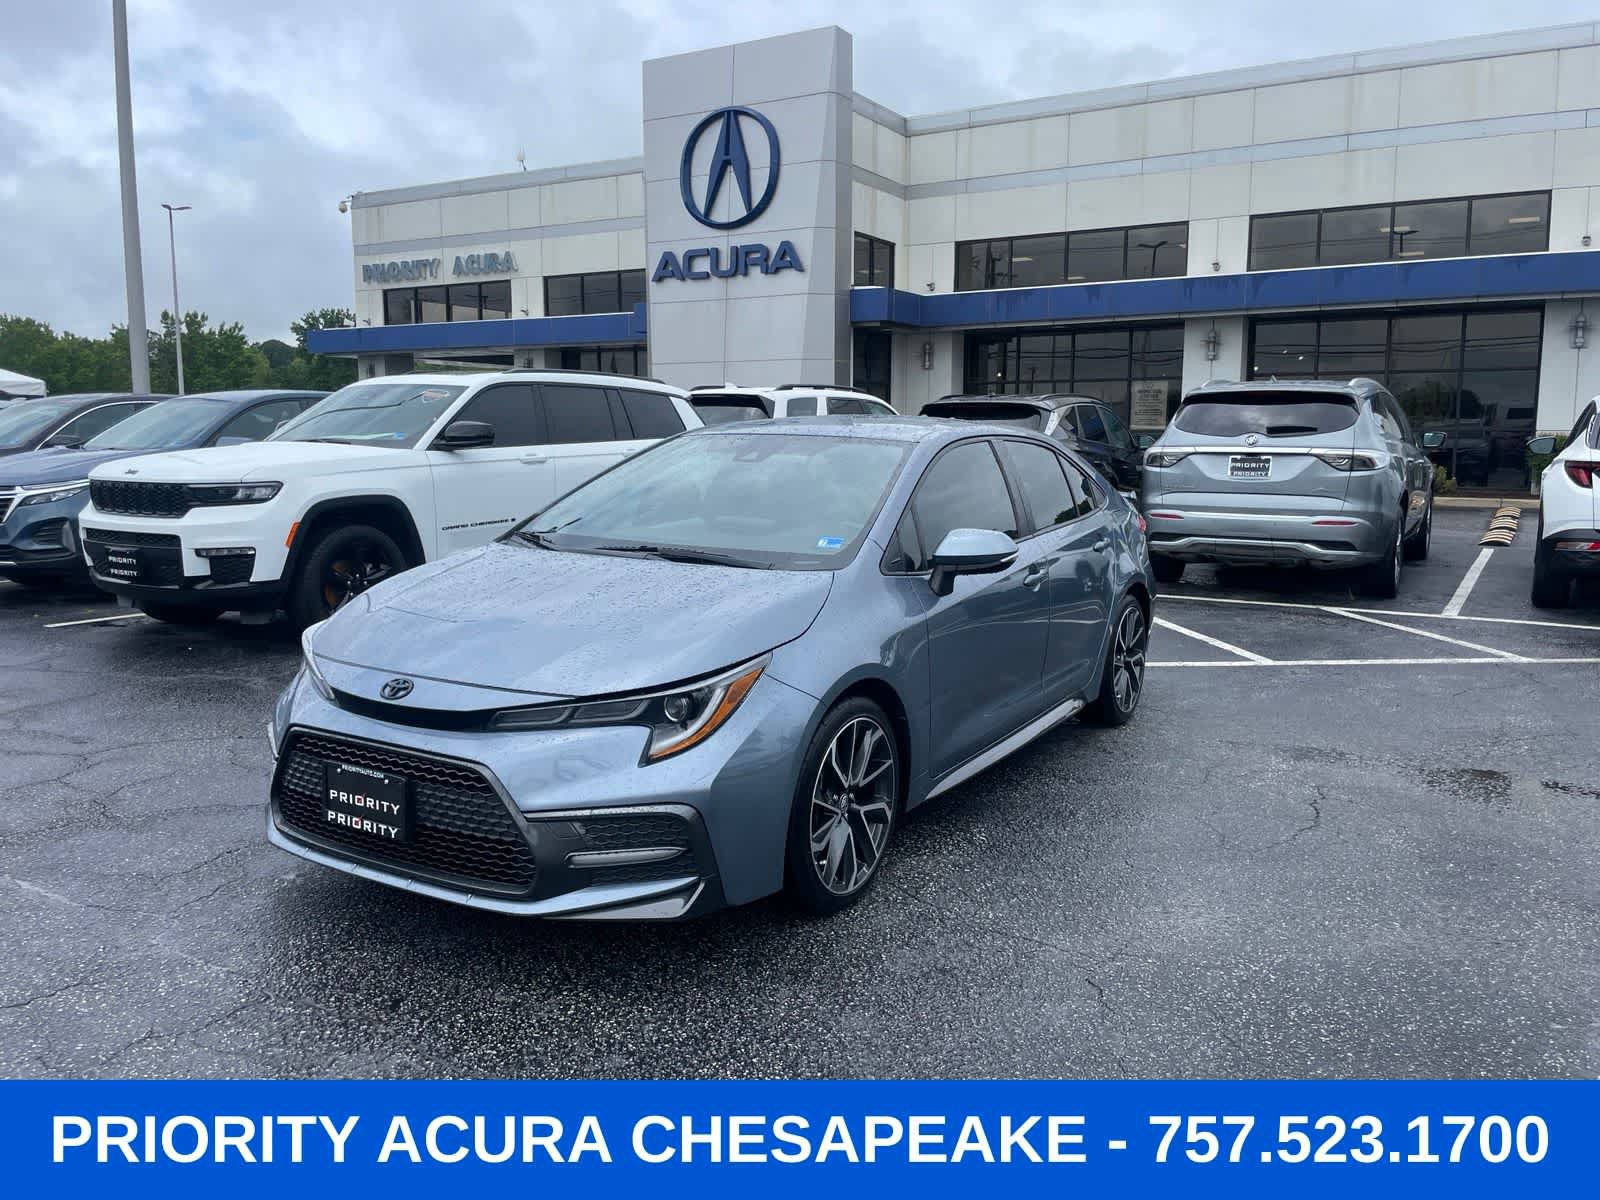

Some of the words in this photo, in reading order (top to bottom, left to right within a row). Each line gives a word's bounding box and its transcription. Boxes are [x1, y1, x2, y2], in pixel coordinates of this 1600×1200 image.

[362, 258, 441, 284] PRIORITY
[453, 250, 518, 278] ACURA
[652, 240, 805, 283] ACURA
[329, 789, 401, 816] PRIORITY
[327, 810, 399, 839] PRIORITY
